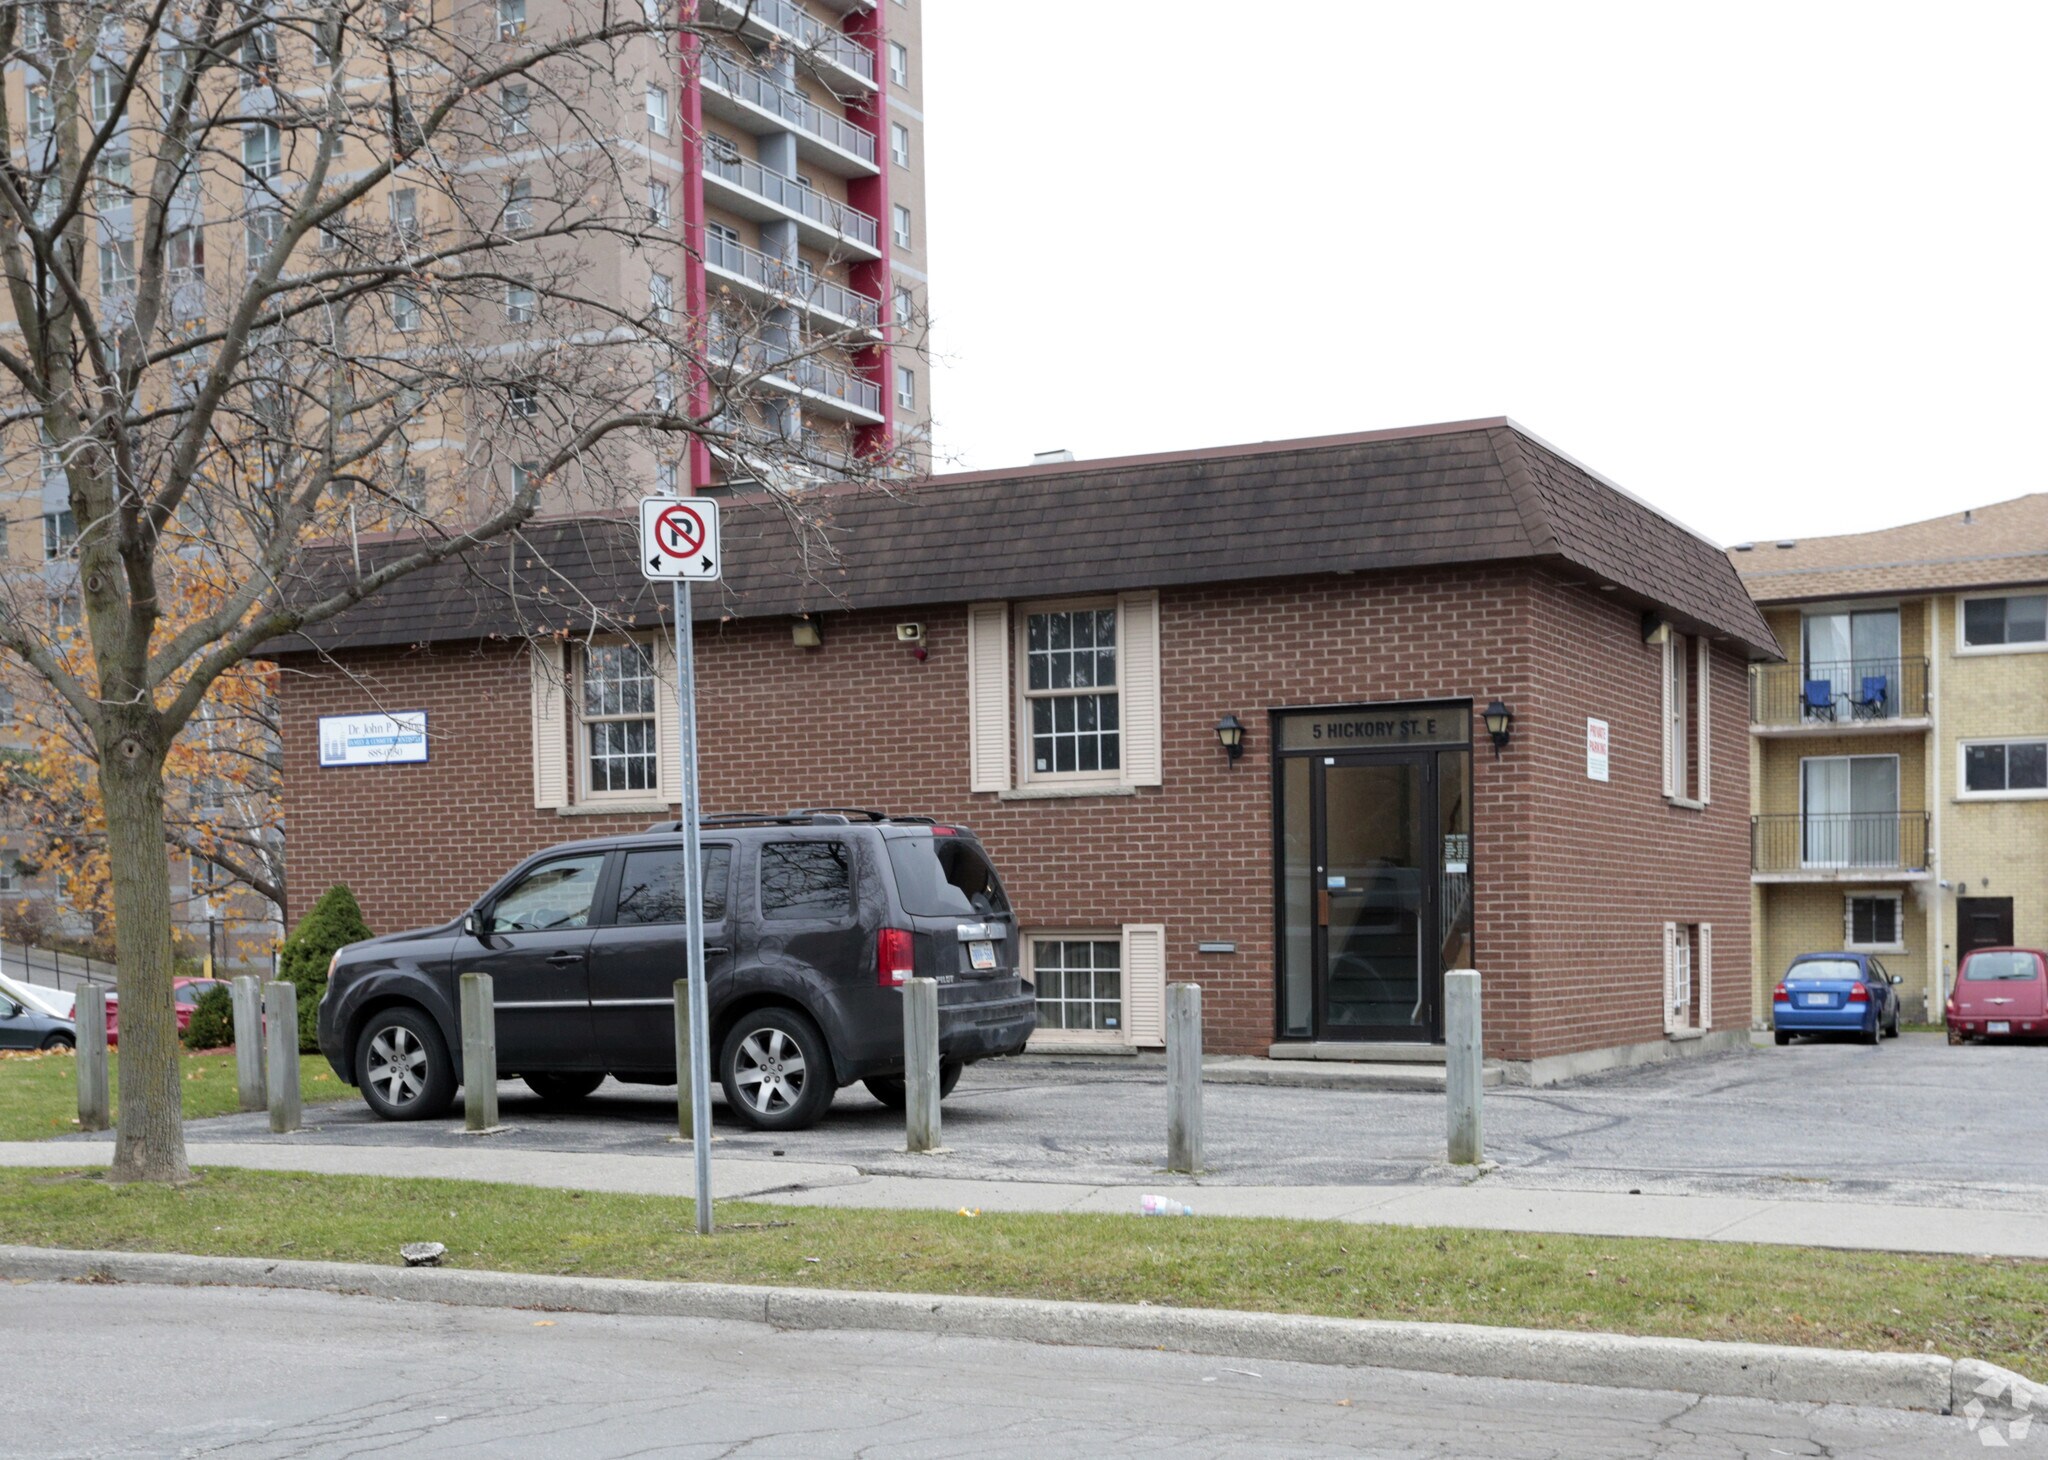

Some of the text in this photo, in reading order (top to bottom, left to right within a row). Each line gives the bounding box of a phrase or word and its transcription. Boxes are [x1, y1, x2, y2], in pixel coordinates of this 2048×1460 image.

[671, 518, 693, 546] P
[348, 724, 361, 735] Dr.
[363, 723, 383, 737] John
[386, 722, 393, 733] P.
[1312, 719, 1437, 739] 5 HICKORY ST. E
